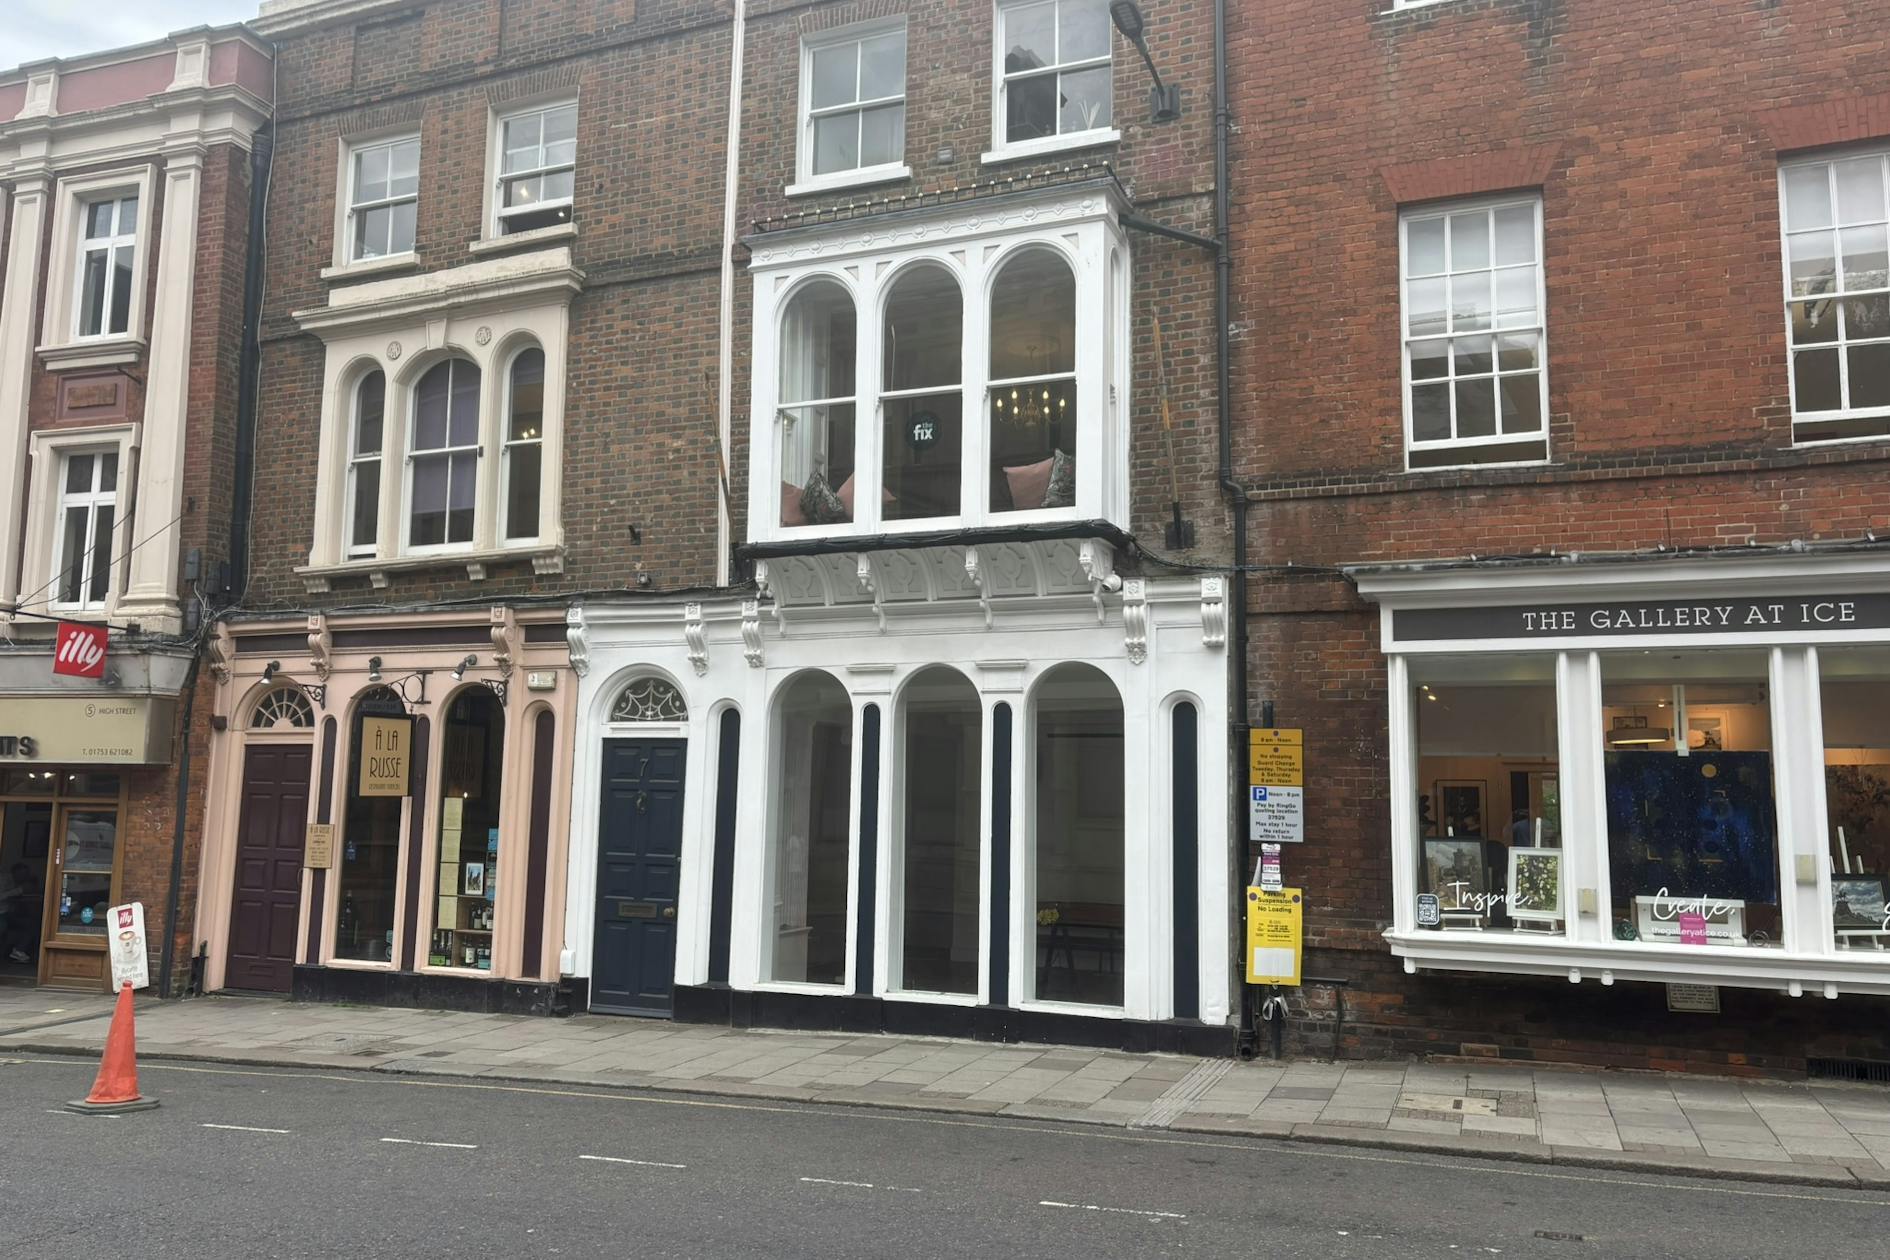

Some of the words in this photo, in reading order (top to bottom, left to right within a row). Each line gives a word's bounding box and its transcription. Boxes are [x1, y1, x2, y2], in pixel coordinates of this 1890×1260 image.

[914, 424, 932, 440] fix
[1522, 611, 1576, 631] THE
[1590, 606, 1734, 629] GALLERY
[1744, 604, 1784, 624] AT
[1800, 602, 1856, 623] ICE
[58, 631, 104, 672] illy
[376, 726, 382, 750] À
[387, 730, 398, 751] LA
[369, 756, 402, 778] RUSSE
[640, 758, 648, 776] 7
[1256, 788, 1265, 800] P
[1653, 886, 1736, 920] Create,
[120, 912, 132, 926] illy
